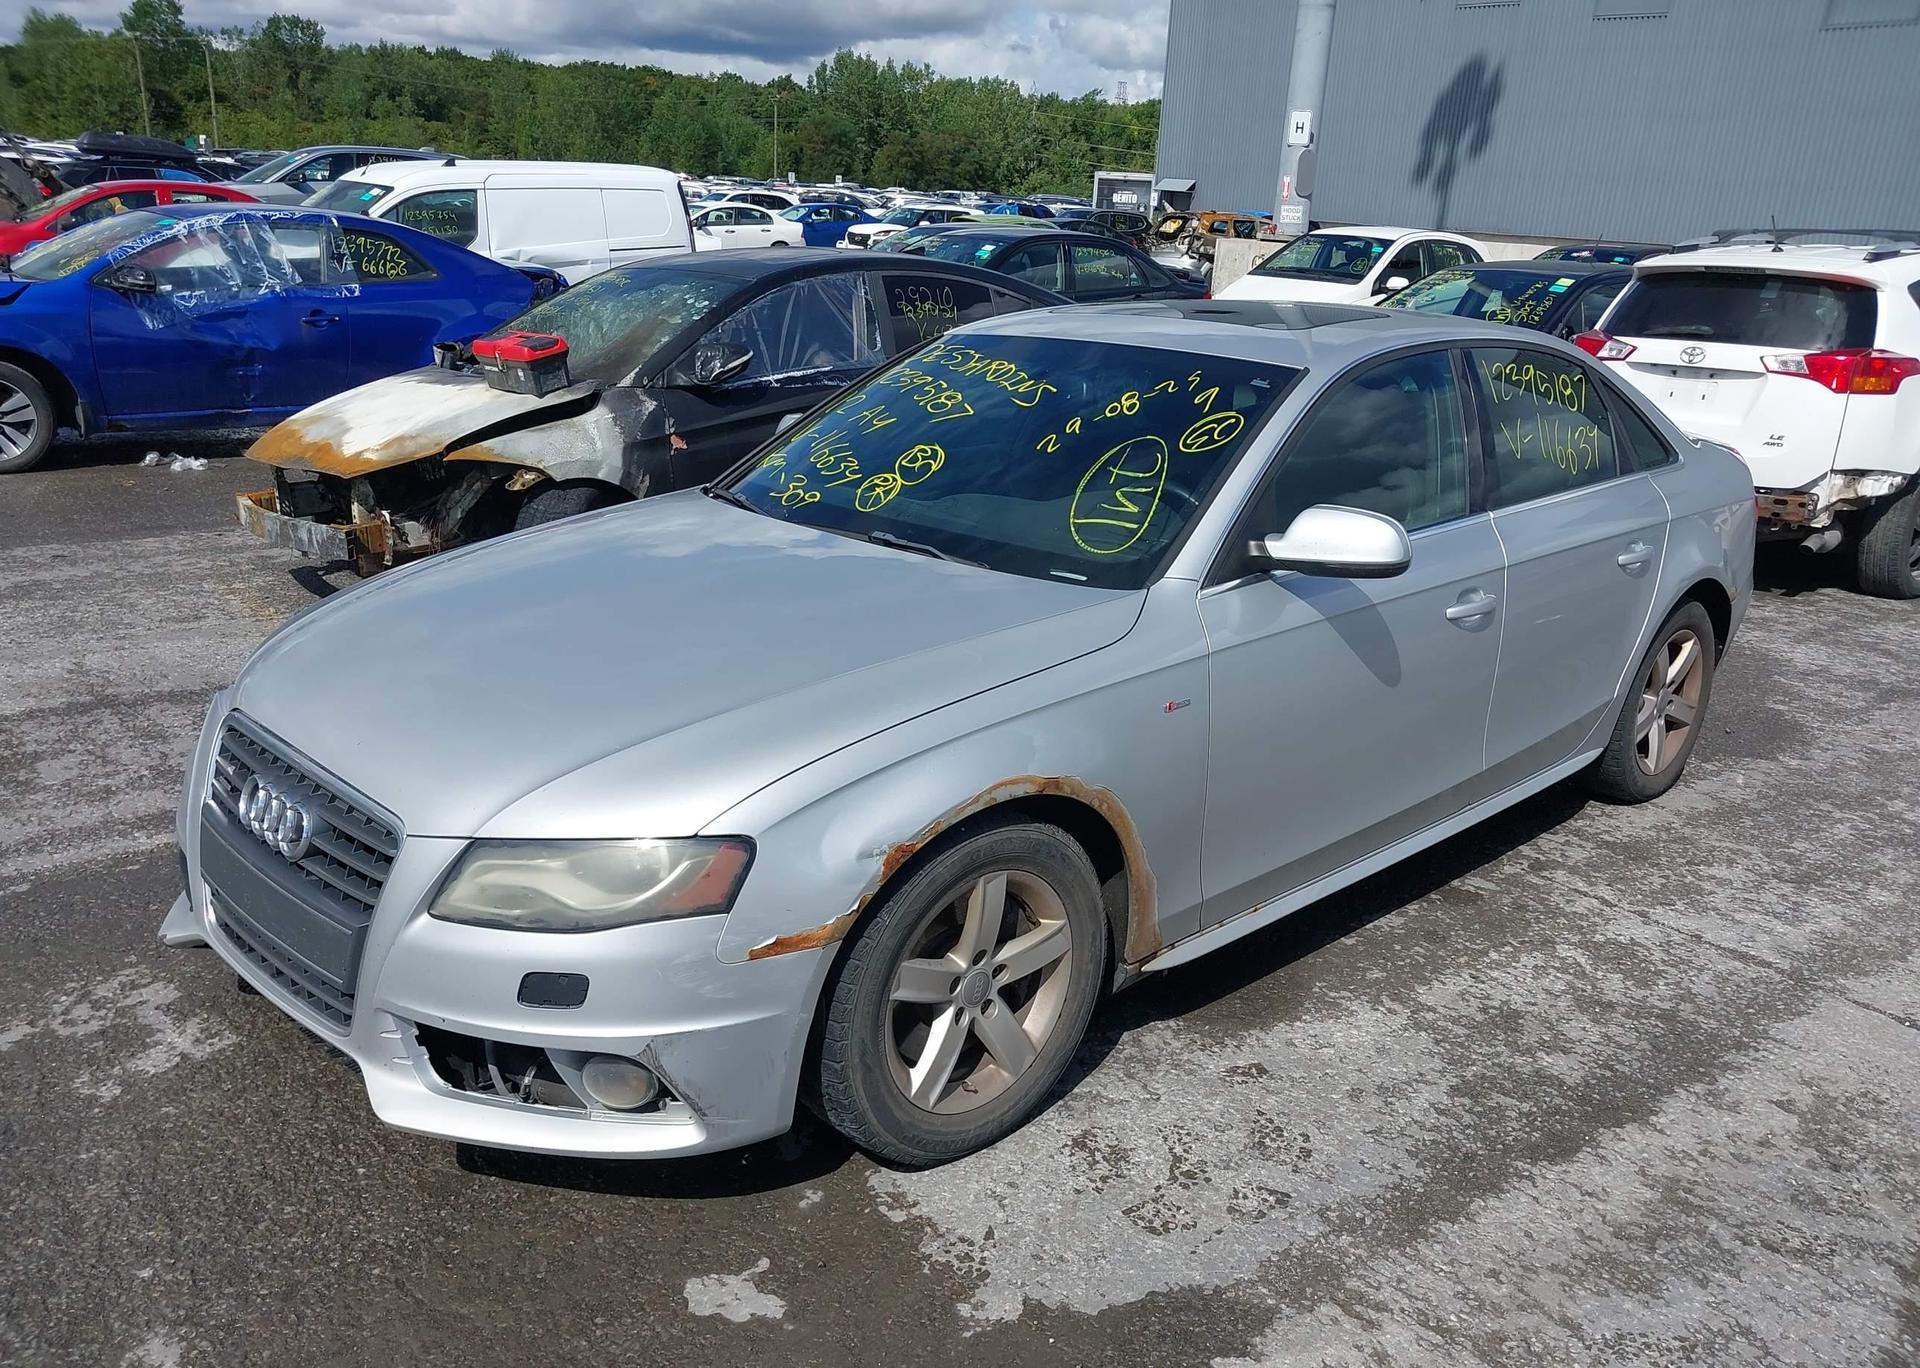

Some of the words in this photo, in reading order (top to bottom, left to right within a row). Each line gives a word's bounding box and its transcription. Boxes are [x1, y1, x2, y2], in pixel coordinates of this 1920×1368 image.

[1295, 121, 1305, 134] H
[906, 343, 1057, 407] DESJARDINS
[1482, 359, 1586, 413] 12395187
